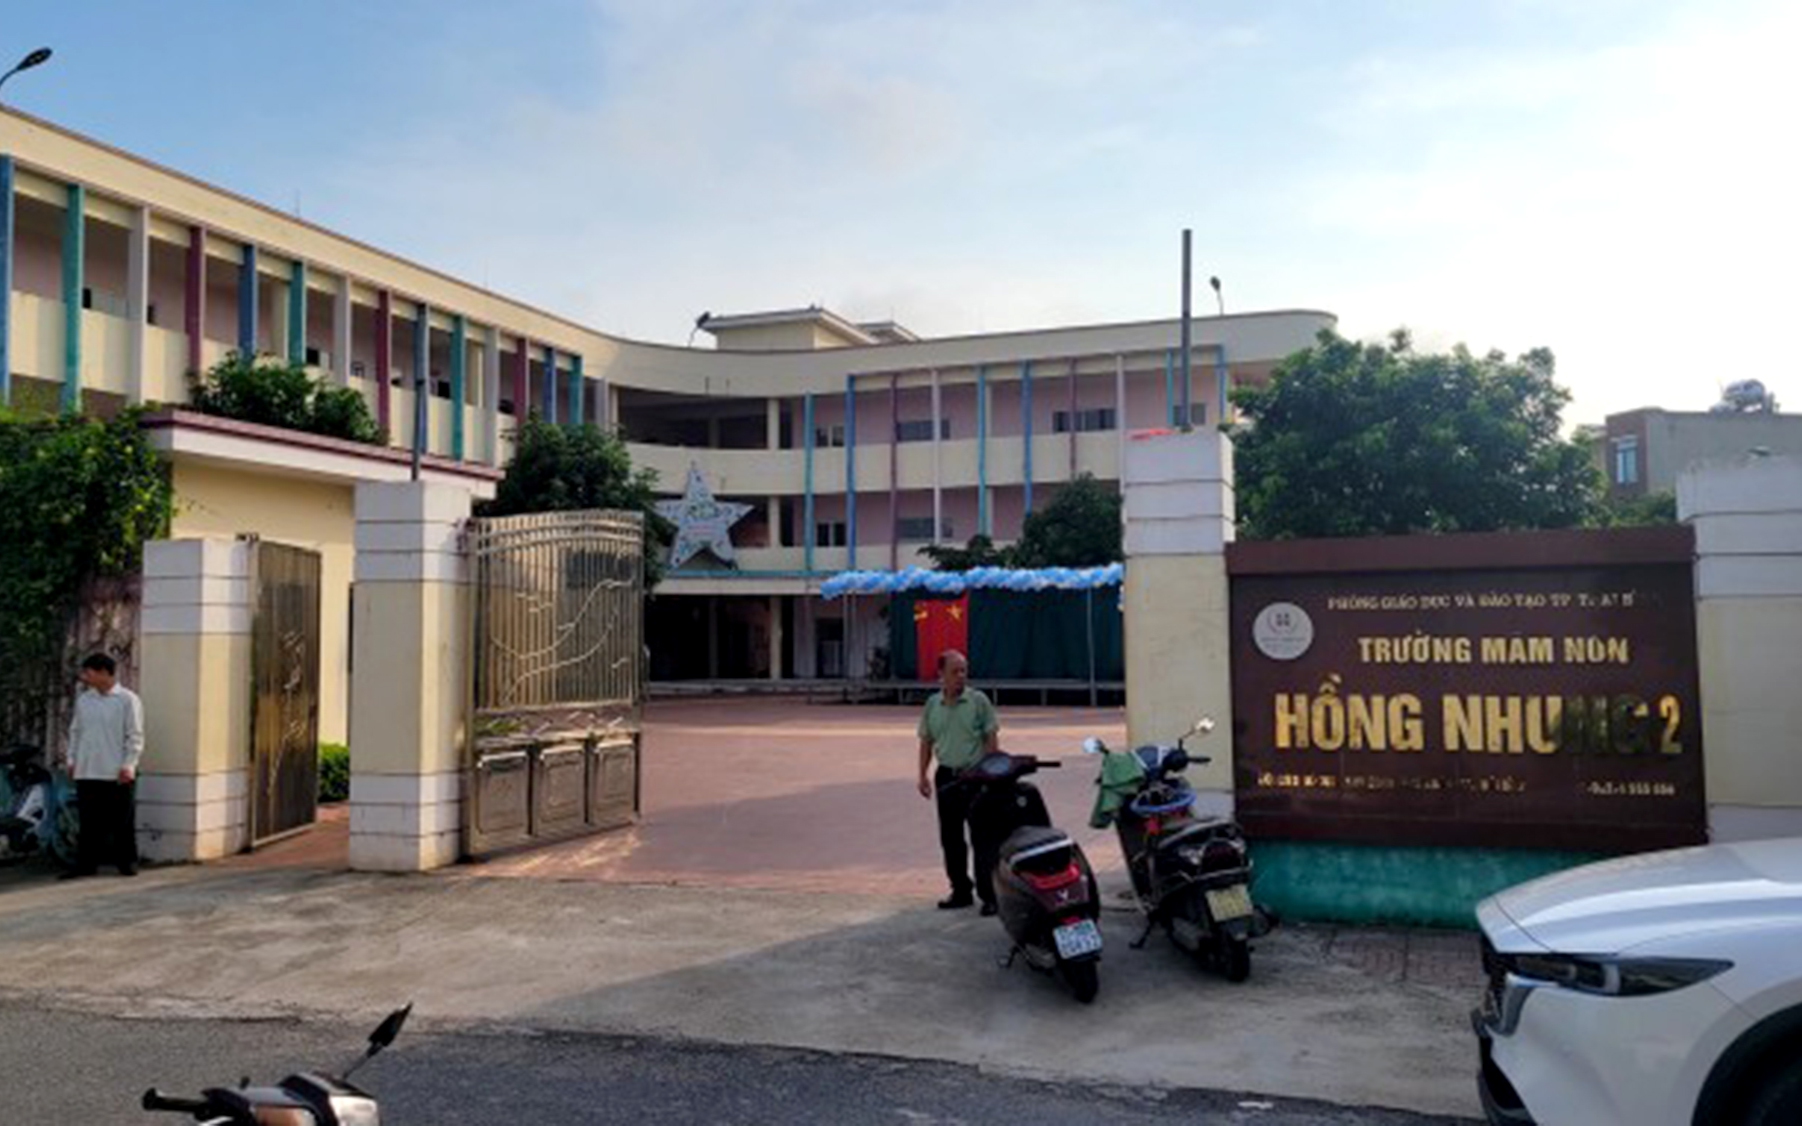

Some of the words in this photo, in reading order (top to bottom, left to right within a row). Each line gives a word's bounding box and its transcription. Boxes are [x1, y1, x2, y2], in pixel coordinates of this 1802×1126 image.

[1358, 629, 1472, 663] TRƯỜNG
[1275, 673, 1425, 751] HỒNG
[1659, 695, 1683, 755] 2
